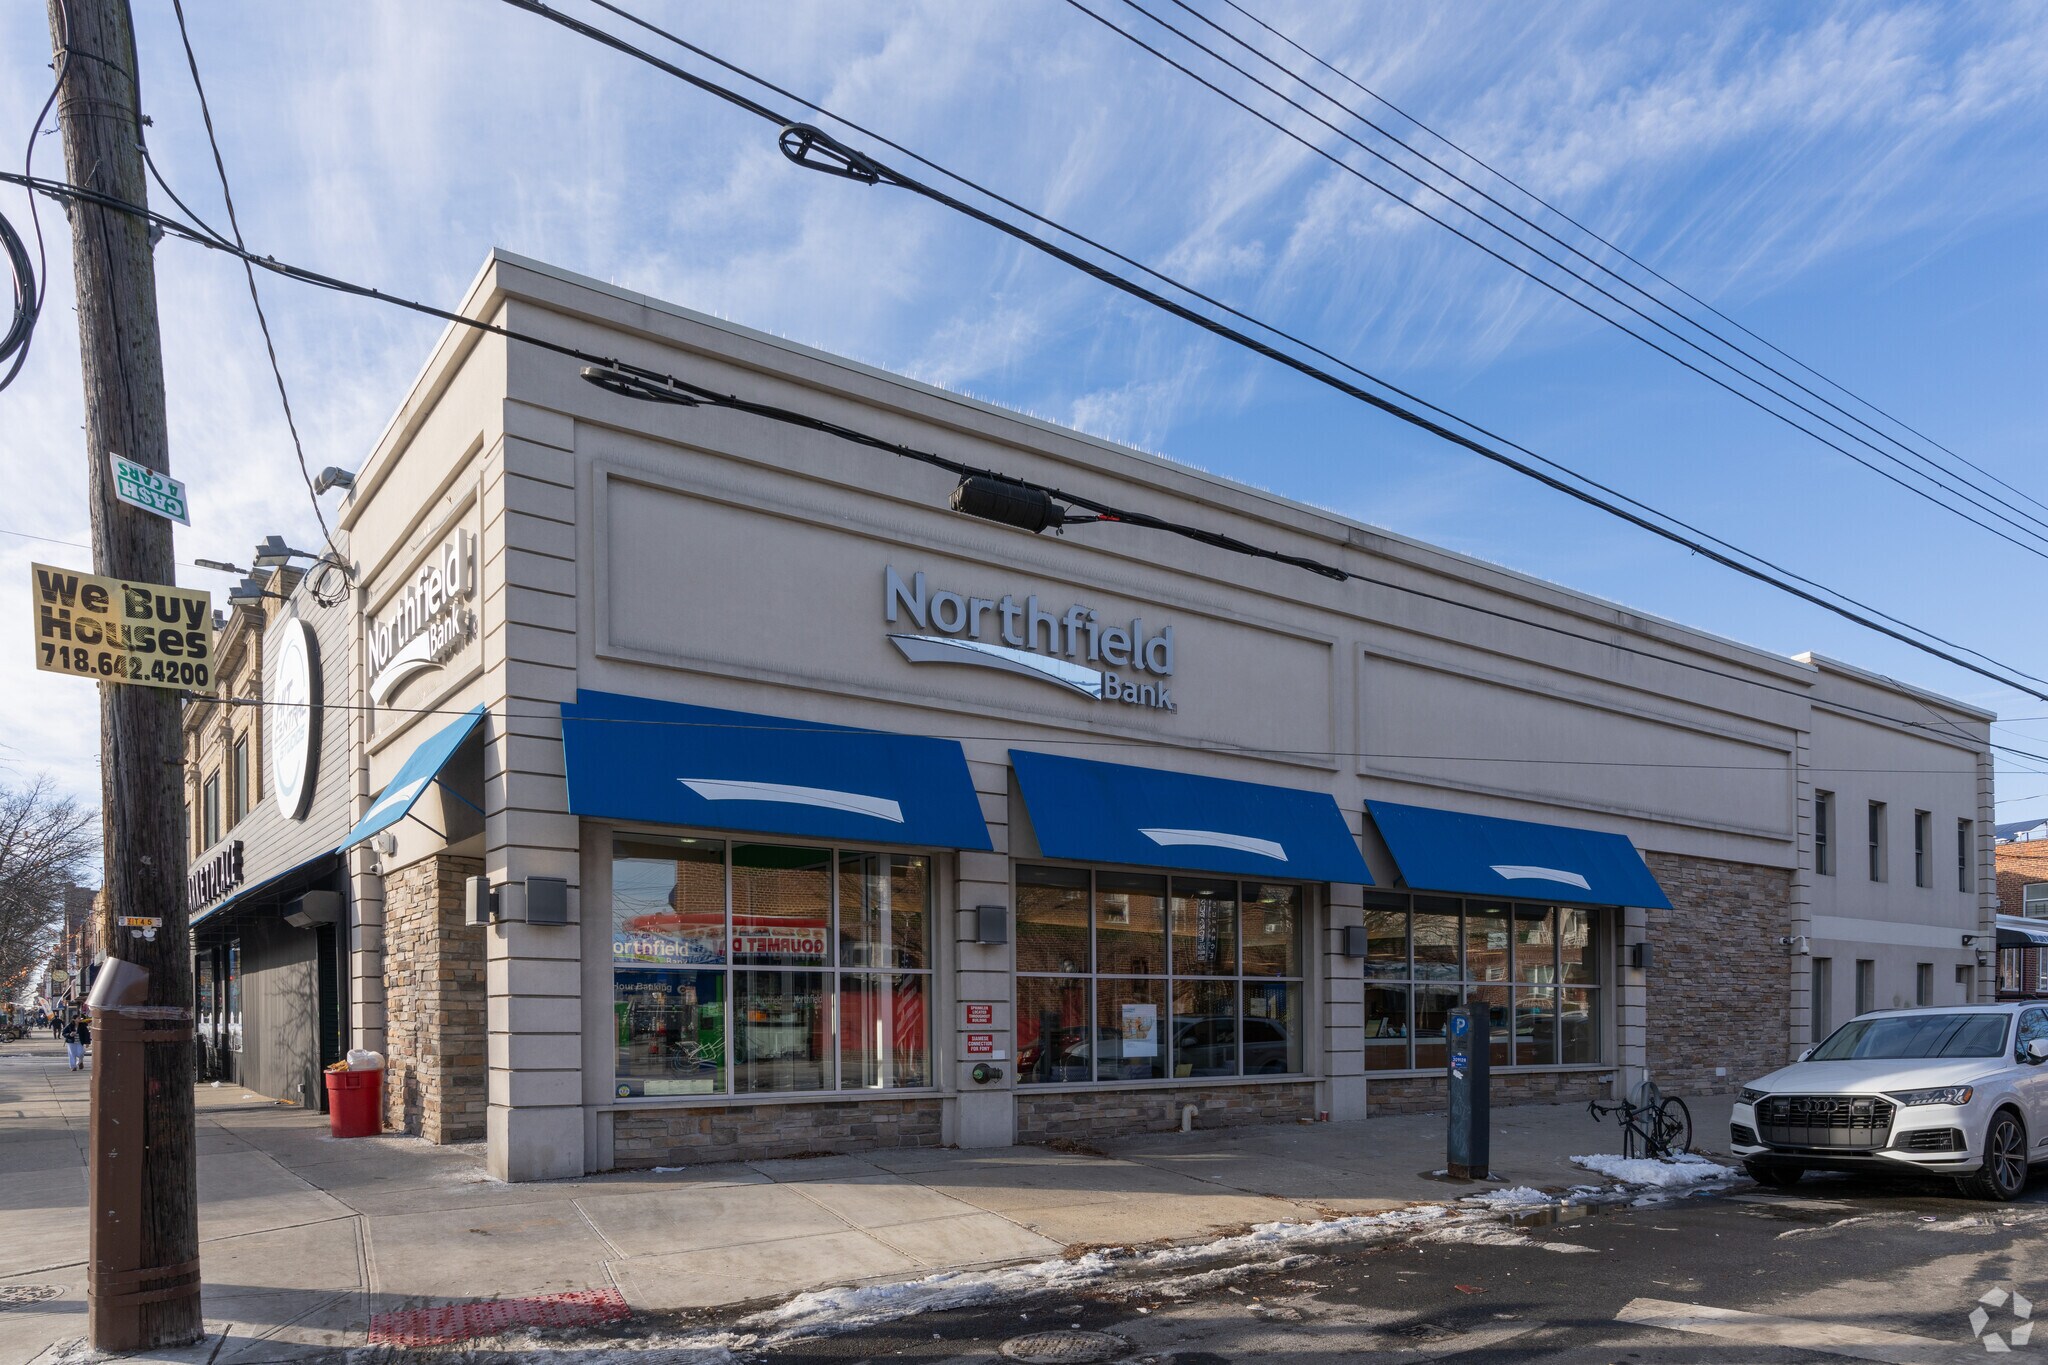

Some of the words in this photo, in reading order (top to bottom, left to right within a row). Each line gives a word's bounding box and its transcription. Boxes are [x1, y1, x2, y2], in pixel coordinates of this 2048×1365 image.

[118, 462, 163, 491] CARS
[168, 483, 178, 497] 4
[37, 569, 110, 614] We
[125, 587, 206, 630] Buy
[369, 528, 465, 677] Northfield
[885, 565, 1174, 677] Northfield
[41, 605, 208, 659] Houses
[430, 603, 463, 657] Bank
[41, 642, 209, 687] 718.642.4200
[1103, 671, 1174, 710] Bank
[188, 840, 241, 912] ARKETPLACE
[613, 939, 690, 957] orthfield
[1456, 1018, 1466, 1034] P
